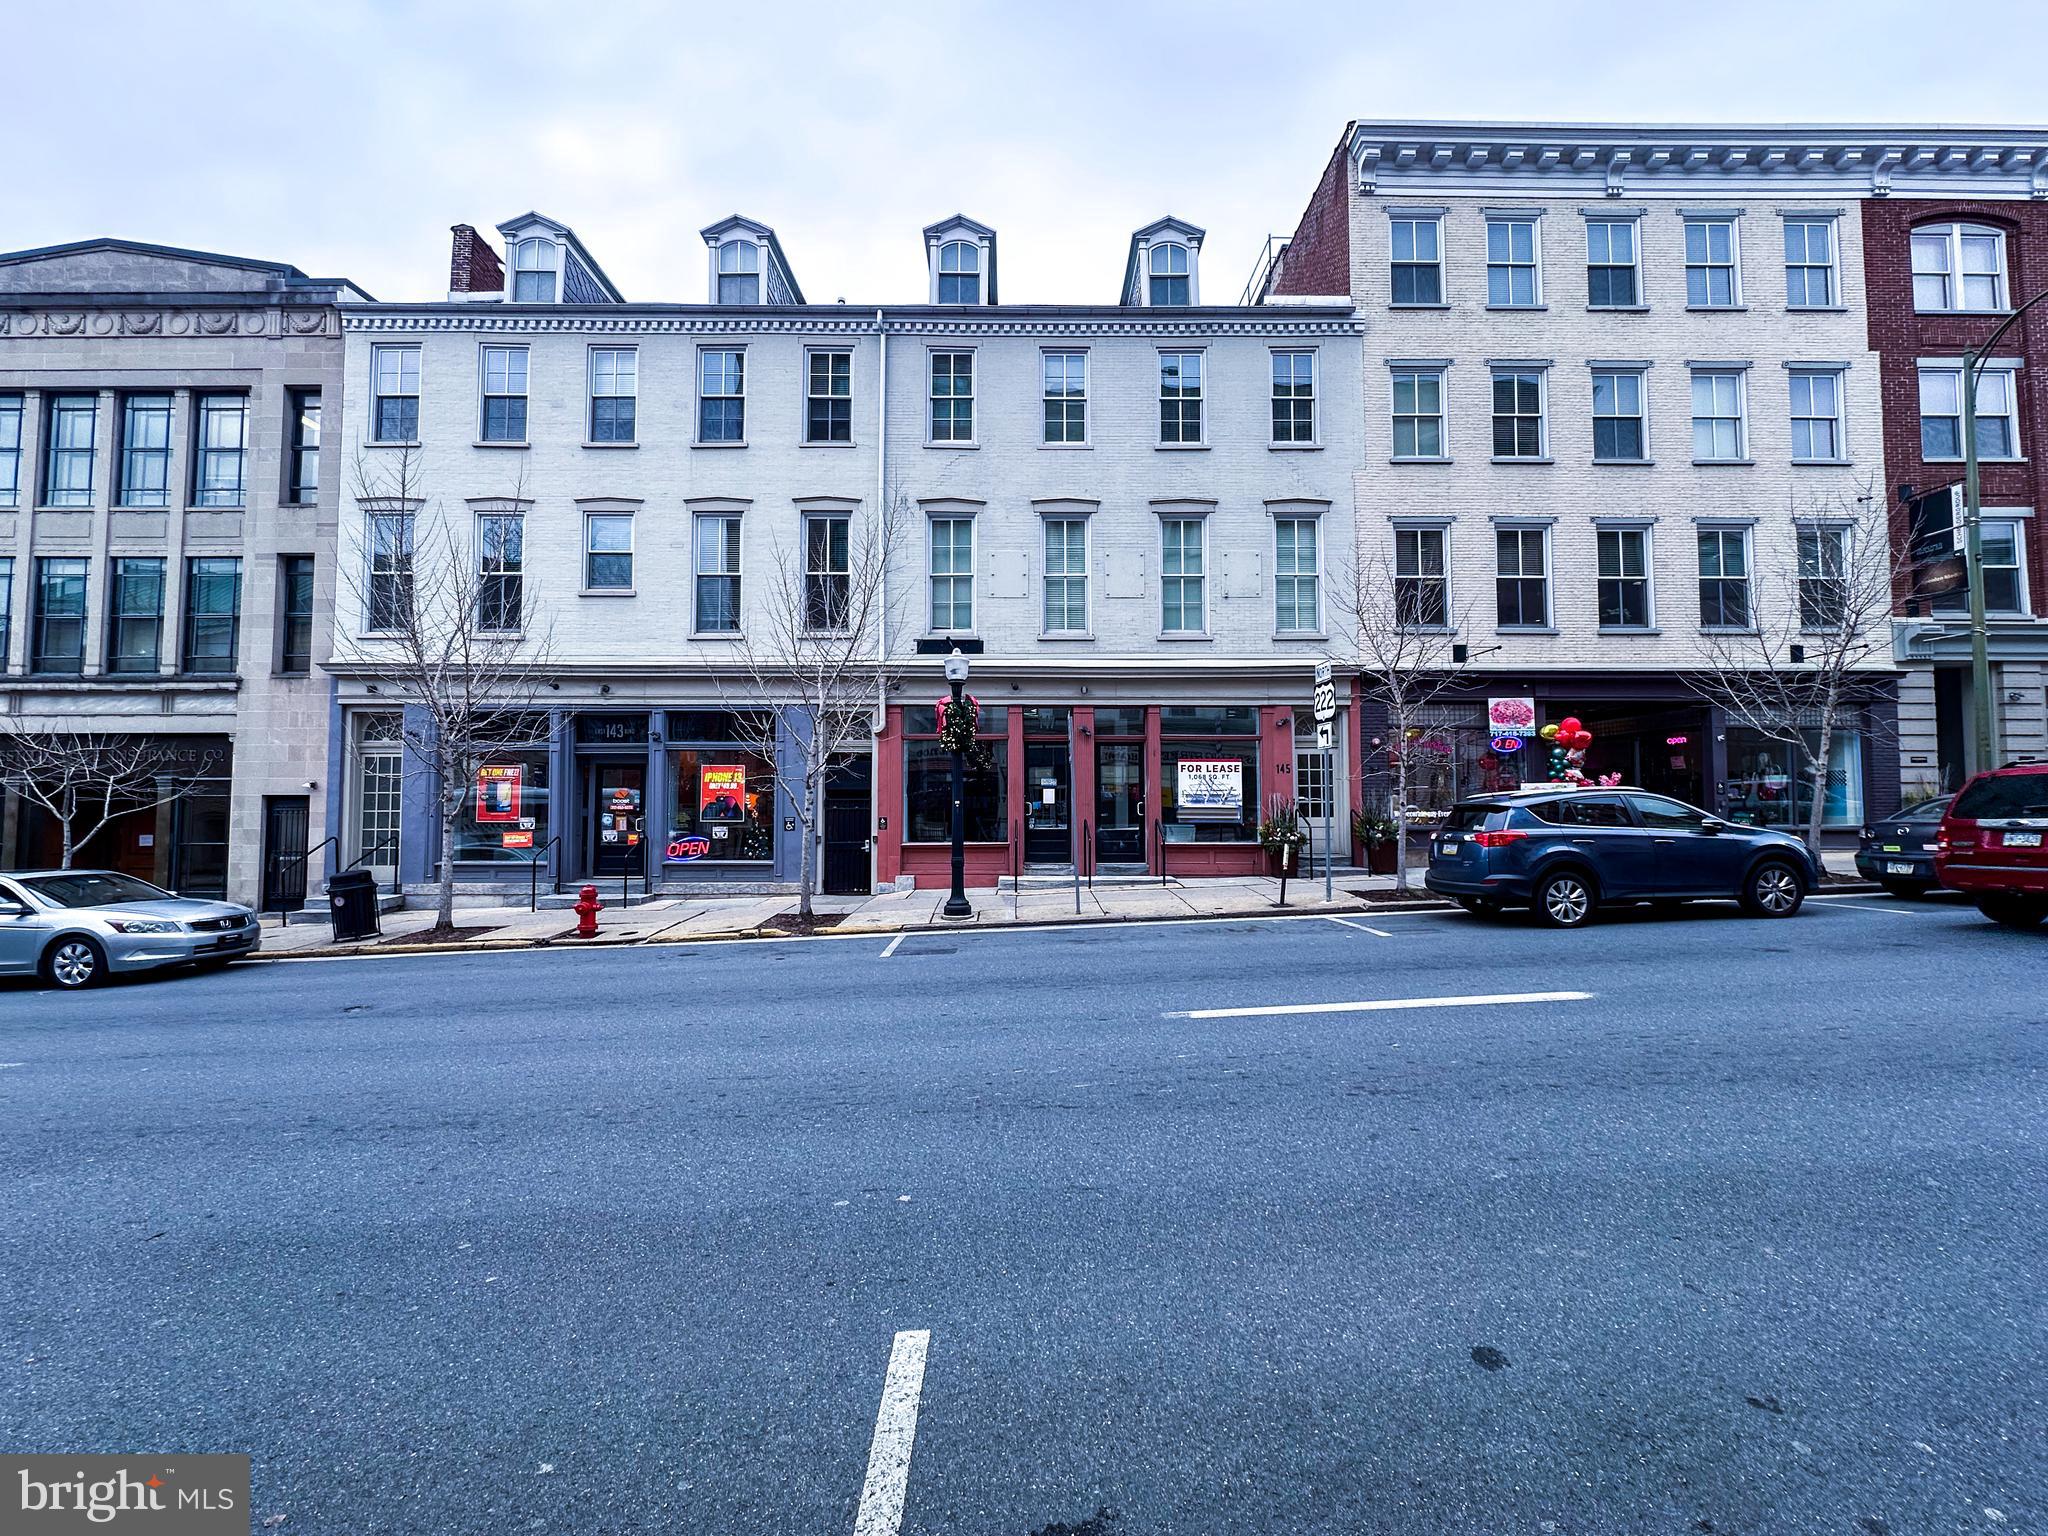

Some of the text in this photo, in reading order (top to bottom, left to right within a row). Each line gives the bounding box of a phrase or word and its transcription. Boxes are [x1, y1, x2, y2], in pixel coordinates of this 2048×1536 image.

[1315, 688, 1334, 713] 222
[605, 723, 624, 738] 143
[1180, 764, 1240, 773] FOR LEASE
[1276, 763, 1291, 775] 145
[667, 841, 710, 856] OPEN
